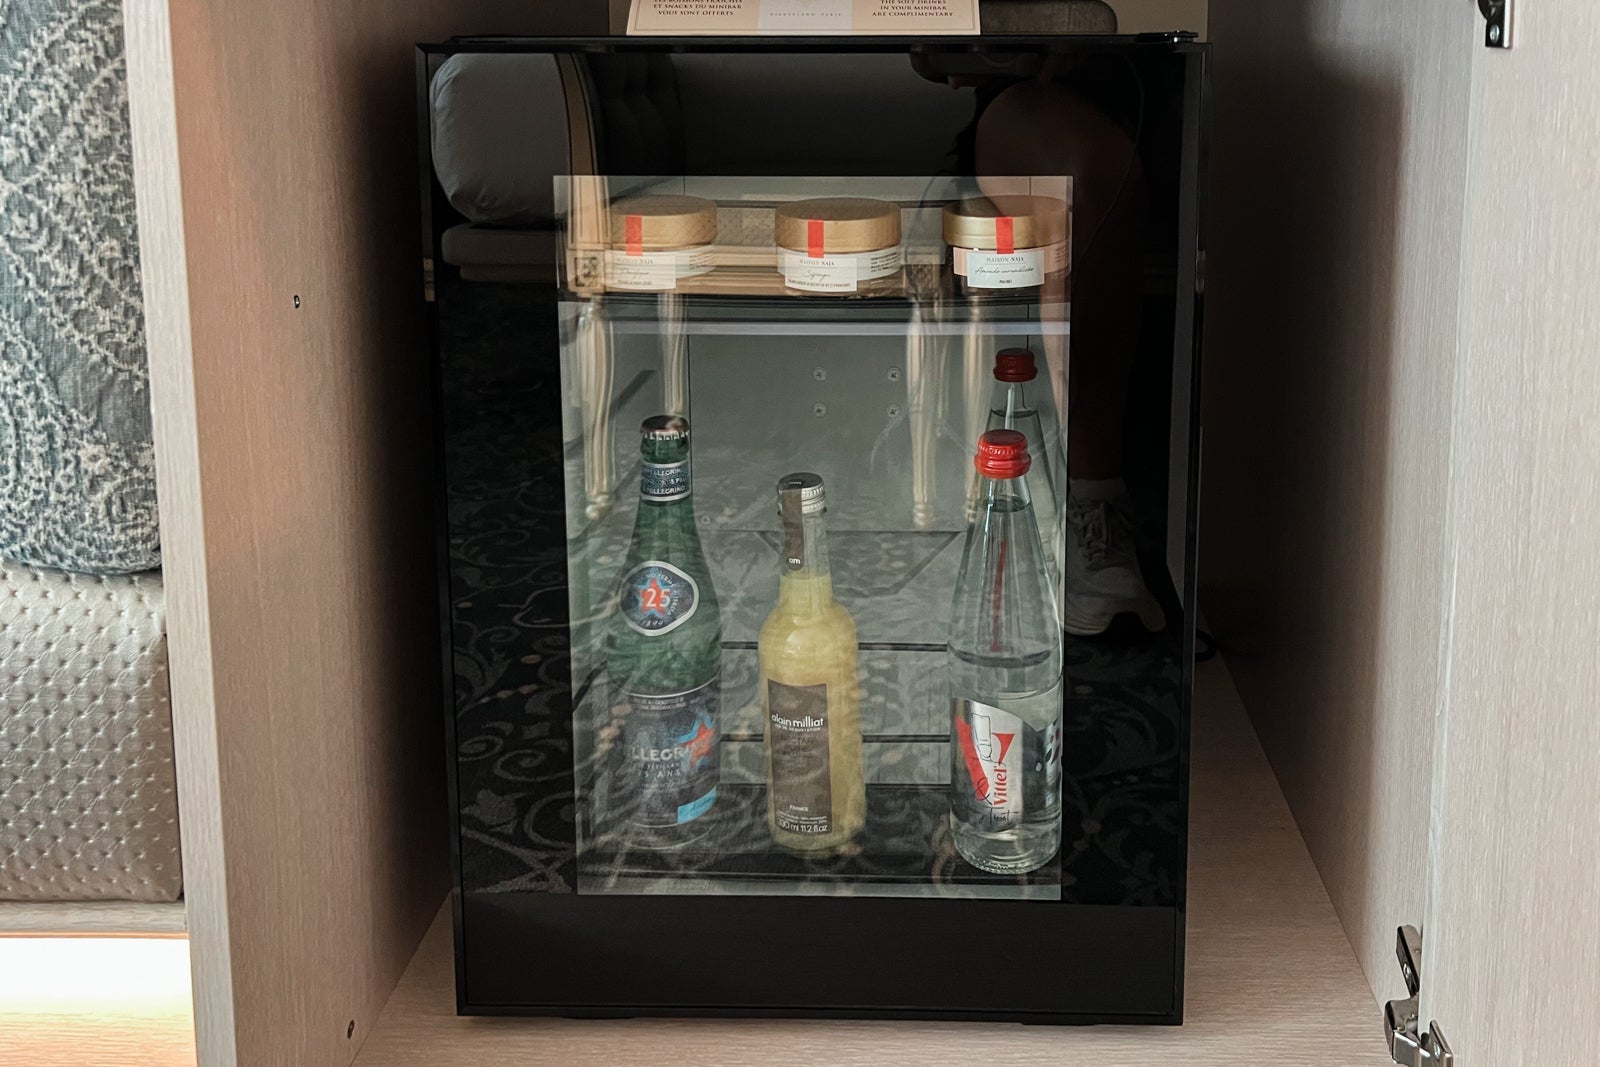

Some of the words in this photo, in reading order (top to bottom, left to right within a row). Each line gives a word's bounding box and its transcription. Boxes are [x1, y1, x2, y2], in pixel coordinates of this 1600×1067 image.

[771, 713, 792, 727] alain
[792, 715, 824, 728] milliat
[993, 768, 1008, 806] Vittel
